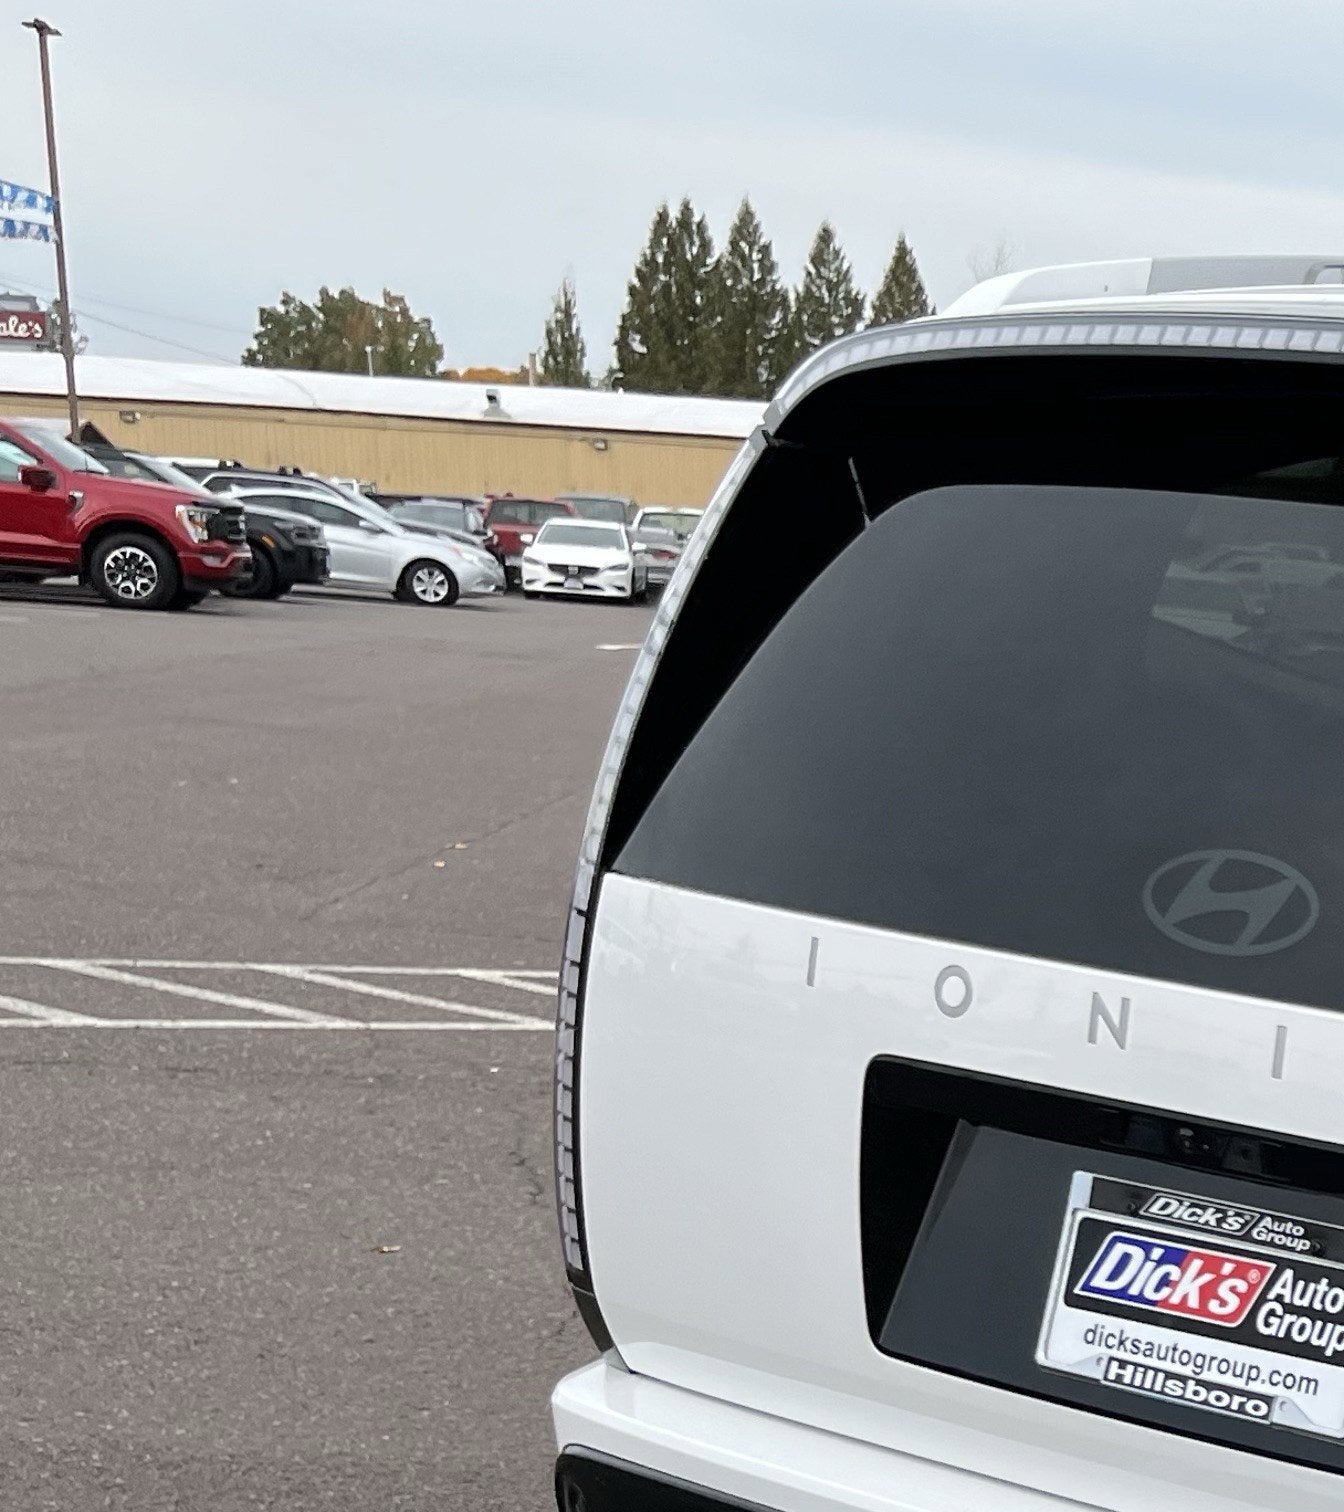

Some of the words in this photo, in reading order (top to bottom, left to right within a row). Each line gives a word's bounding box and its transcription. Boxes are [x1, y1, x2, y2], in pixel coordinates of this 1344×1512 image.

[1149, 1197, 1247, 1232] Dick's
[1257, 1216, 1305, 1237] Auto
[1251, 1227, 1312, 1252] Group
[1089, 1241, 1250, 1316] Dick's
[1083, 1323, 1319, 1397] dicksautogroup.com
[1104, 1361, 1271, 1418] Hillsboro
